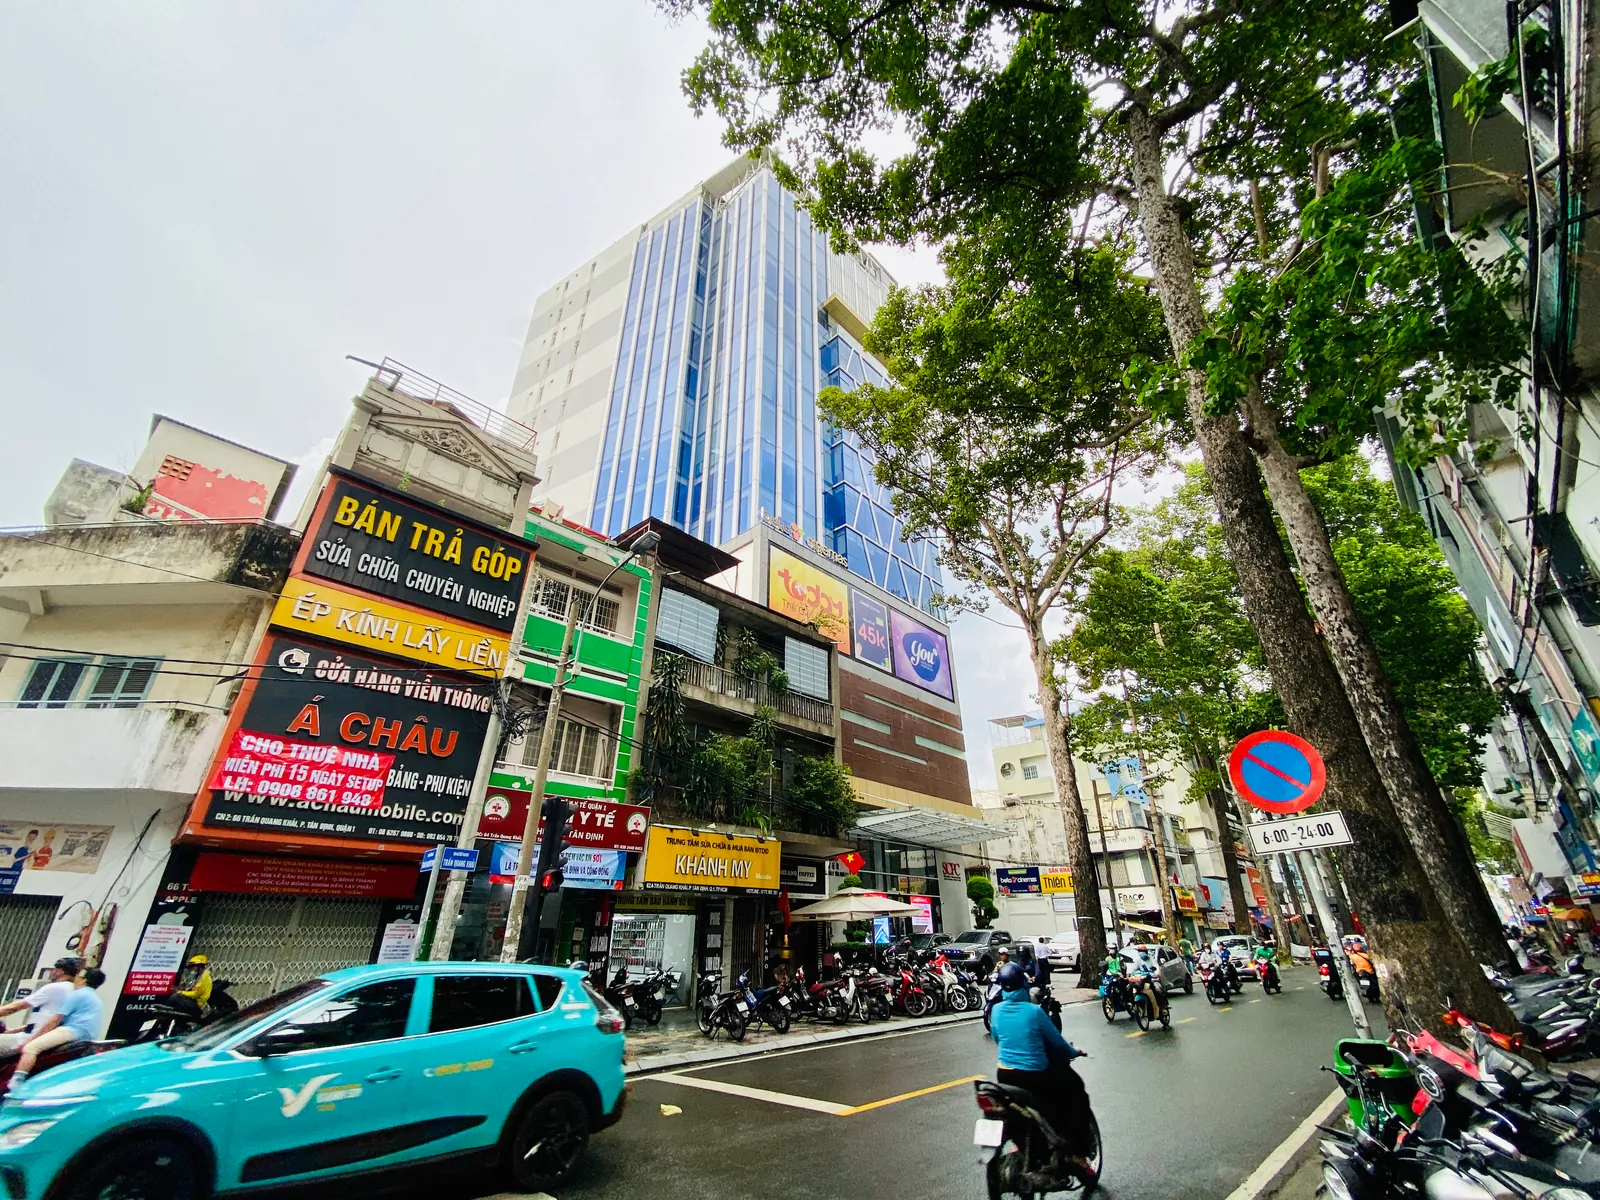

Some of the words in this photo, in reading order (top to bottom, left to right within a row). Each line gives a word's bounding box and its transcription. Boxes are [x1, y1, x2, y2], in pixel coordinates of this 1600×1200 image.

[333, 495, 403, 542] BÁN
[410, 521, 463, 566] TRẢ
[471, 545, 522, 583] GÓP
[315, 537, 353, 569] SỬA
[357, 552, 400, 584] CHỮA
[405, 568, 464, 603] CHUYÊN
[466, 587, 516, 620] NGHIỆP
[291, 591, 332, 622] ÉP
[336, 607, 399, 643] KÍNH
[403, 625, 451, 655] LẤY
[455, 638, 503, 670] LIỀN
[354, 667, 402, 695] HÀNG
[404, 674, 443, 703] VIỄN
[443, 687, 491, 714] THÔNG
[286, 695, 322, 737] Á
[339, 712, 460, 758] CHÂU
[240, 735, 284, 756] CHO
[289, 744, 342, 765] THUÊ
[341, 752, 380, 772] NHÀ
[260, 761, 286, 780] PHÍ
[290, 763, 310, 782] 15
[308, 769, 345, 788] NGÀY
[345, 774, 384, 792] SETUP
[386, 765, 420, 790] BẢNG
[423, 776, 447, 797] PHỤ
[446, 774, 472, 801] KIỆN
[223, 776, 252, 793] LH:
[257, 780, 303, 798] 0908
[306, 786, 337, 803] 861
[341, 791, 373, 807] 948
[580, 800, 588, 809] TẾ
[587, 801, 603, 811] QUẬN
[260, 817, 283, 826] QUANG
[580, 811, 592, 825] Y
[595, 809, 618, 828] TẾ
[568, 829, 584, 841] TÂN
[585, 831, 605, 842] ĐỊNH
[665, 837, 686, 846] TRUNG
[687, 838, 700, 848] TÂM
[712, 841, 727, 850] CHỮA
[1262, 829, 1289, 845] 6:00
[1297, 822, 1335, 841] 24:00
[675, 852, 728, 877] KHÁNH
[730, 860, 753, 880] MY
[167, 882, 180, 891] 66
[1043, 876, 1066, 888] Thiên
[164, 896, 198, 904] APPLE
